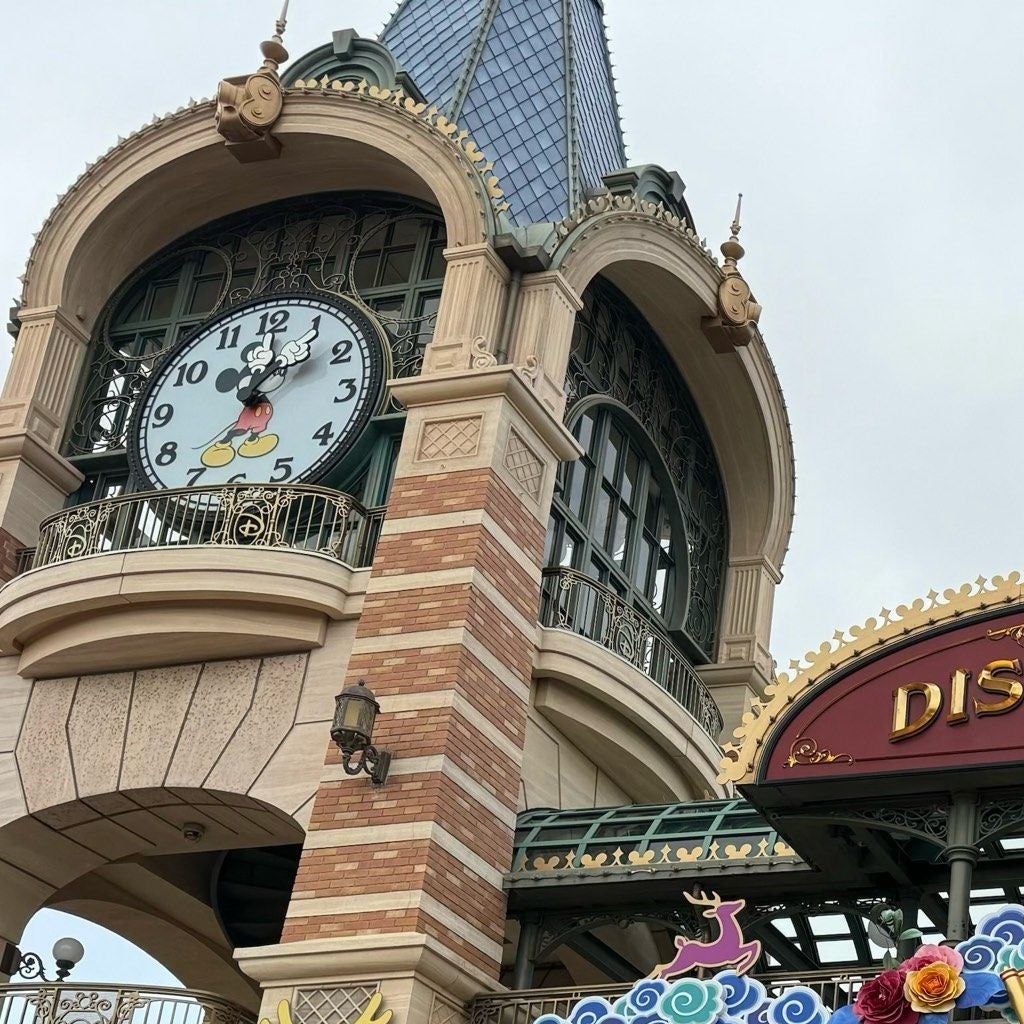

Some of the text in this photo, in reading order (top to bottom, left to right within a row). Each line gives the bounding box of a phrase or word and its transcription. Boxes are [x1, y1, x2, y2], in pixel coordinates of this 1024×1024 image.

[255, 309, 290, 336] 12
[311, 315, 323, 333] 1
[215, 325, 242, 350] 11
[329, 340, 353, 365] 2
[173, 360, 208, 387] 10
[334, 378, 357, 403] 3
[152, 403, 174, 428] 9
[312, 422, 334, 446] 4
[154, 441, 178, 466] 8
[185, 467, 207, 487] 7
[269, 457, 294, 483] 5
